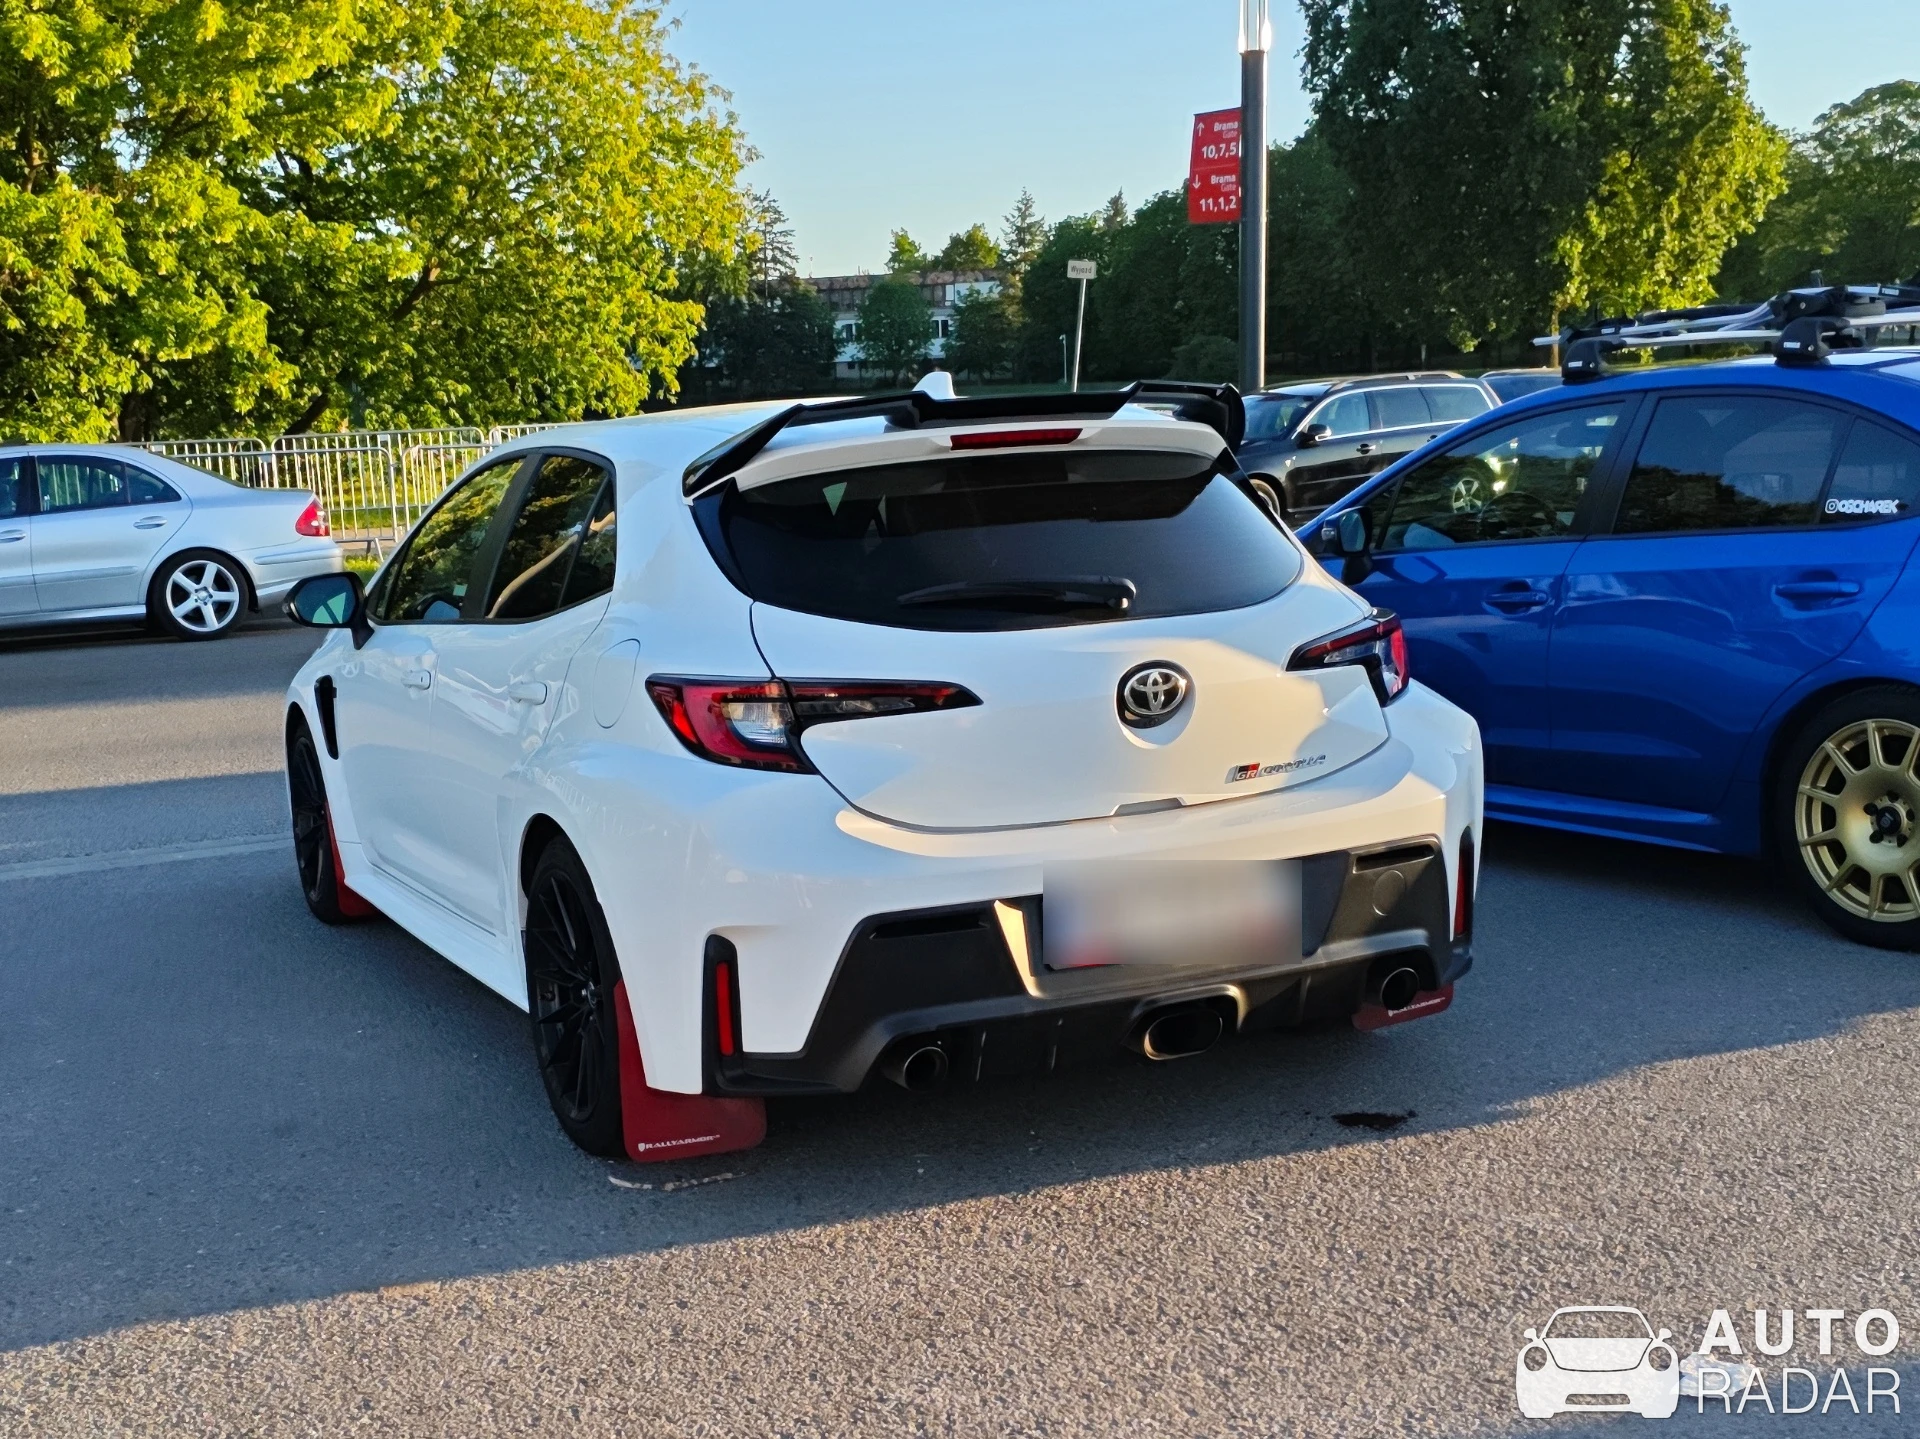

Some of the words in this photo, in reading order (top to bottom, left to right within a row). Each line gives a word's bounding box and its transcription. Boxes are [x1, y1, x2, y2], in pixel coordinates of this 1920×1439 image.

[1214, 121, 1238, 132] Brama
[1202, 142, 1237, 159] 10,7,5
[1211, 174, 1236, 185] Brama
[1199, 195, 1237, 212] 11,1,2
[1236, 769, 1257, 780] GR
